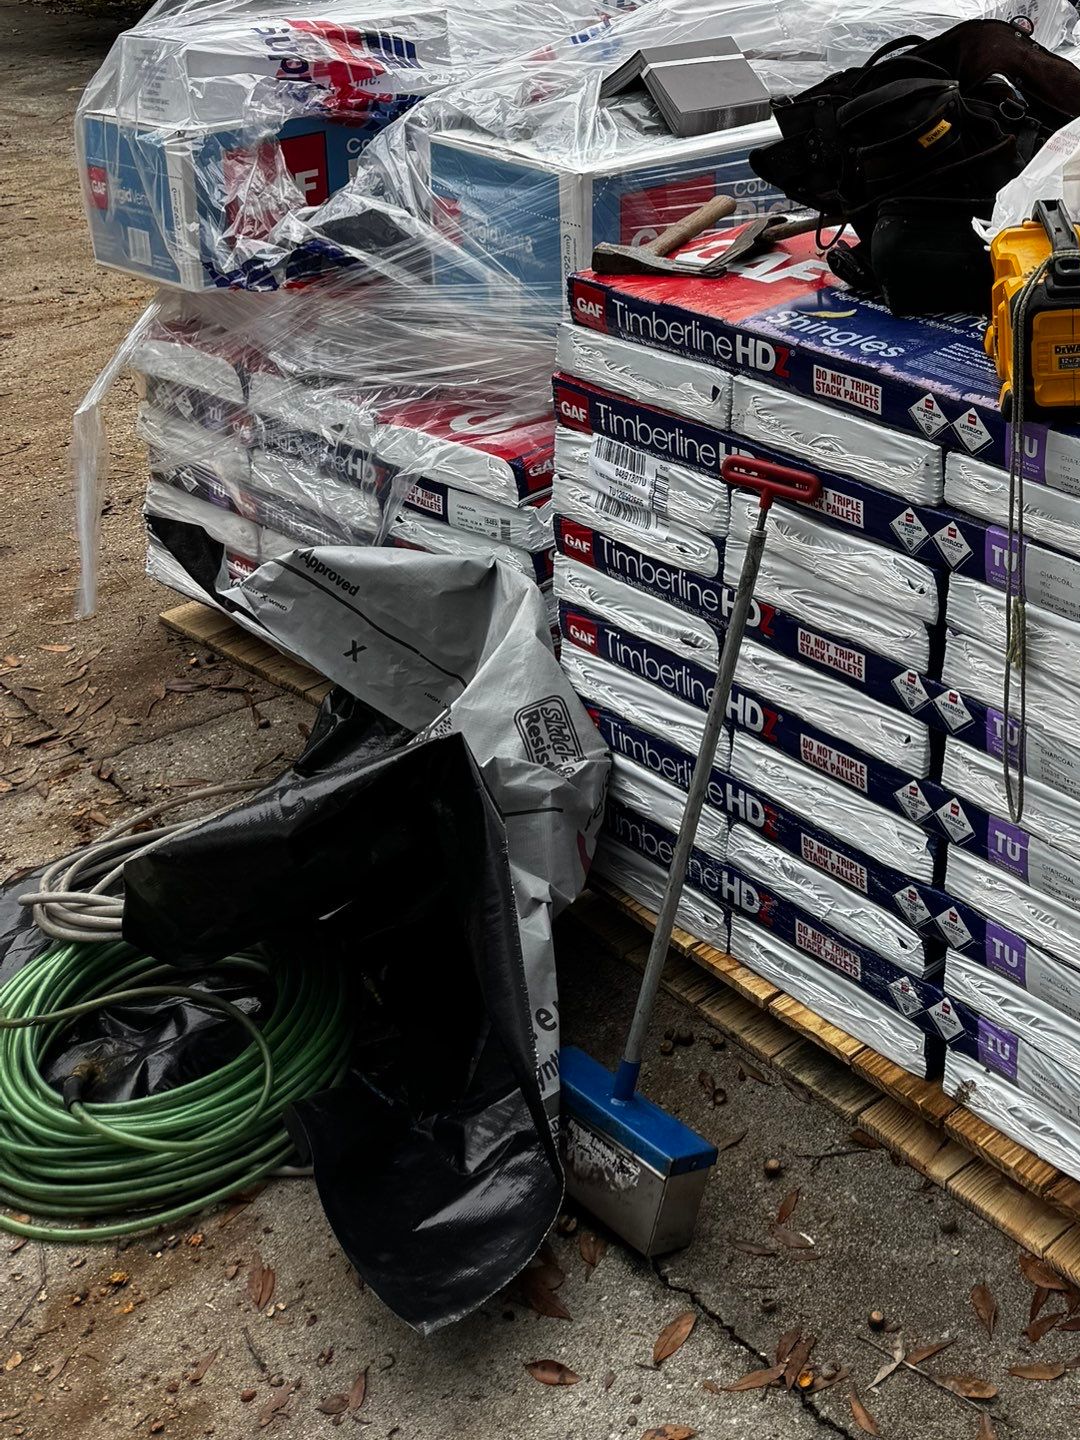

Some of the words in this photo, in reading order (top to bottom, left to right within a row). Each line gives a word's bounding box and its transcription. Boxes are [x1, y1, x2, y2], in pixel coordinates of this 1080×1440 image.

[576, 297, 603, 319] GAF
[765, 307, 905, 359] Shingles
[815, 382, 842, 399] STACK
[844, 389, 879, 411] PALLETS
[816, 368, 827, 381] DO
[830, 372, 846, 387] NOT
[851, 378, 879, 398] TRIPLE
[560, 401, 588, 420] GAF
[529, 459, 554, 477] GA
[213, 483, 225, 497] TU
[416, 495, 441, 512] PALLETS
[421, 487, 441, 503] TRIPLE
[833, 494, 861, 511] TRIPLE
[826, 503, 861, 525] PALLETS
[564, 533, 591, 554] GAF
[300, 549, 361, 596] Approved
[991, 544, 1018, 573] TU
[1040, 571, 1074, 590] CHARCOAL
[269, 598, 287, 611] WIND
[569, 626, 596, 647] GAF
[800, 632, 811, 644] DO
[814, 637, 830, 653] NOT
[834, 646, 863, 666] TRIPLE
[342, 640, 367, 663] X
[800, 642, 827, 662] STACK
[828, 655, 863, 679] PALLETS
[541, 707, 576, 766] Skid-
[993, 716, 1019, 745] TU
[802, 737, 813, 750] DO
[816, 744, 833, 760] NOT
[836, 753, 865, 777] TRIPLE
[802, 749, 829, 768] STACK
[830, 763, 865, 790] PALLETS
[803, 839, 814, 852] DO
[817, 845, 833, 861] NOT
[836, 855, 865, 876] TRIPLE
[995, 829, 1021, 862] TU
[803, 847, 830, 869] STACK
[830, 864, 865, 890] PALLETS
[1041, 863, 1075, 885] CHARCOAL
[797, 922, 808, 935] DO
[811, 929, 828, 947] NOT
[831, 938, 859, 965] TRIPLE
[798, 933, 823, 957] STACK
[824, 949, 859, 977] PALLETS
[992, 937, 1018, 967] TU
[985, 1034, 1010, 1060] TU
